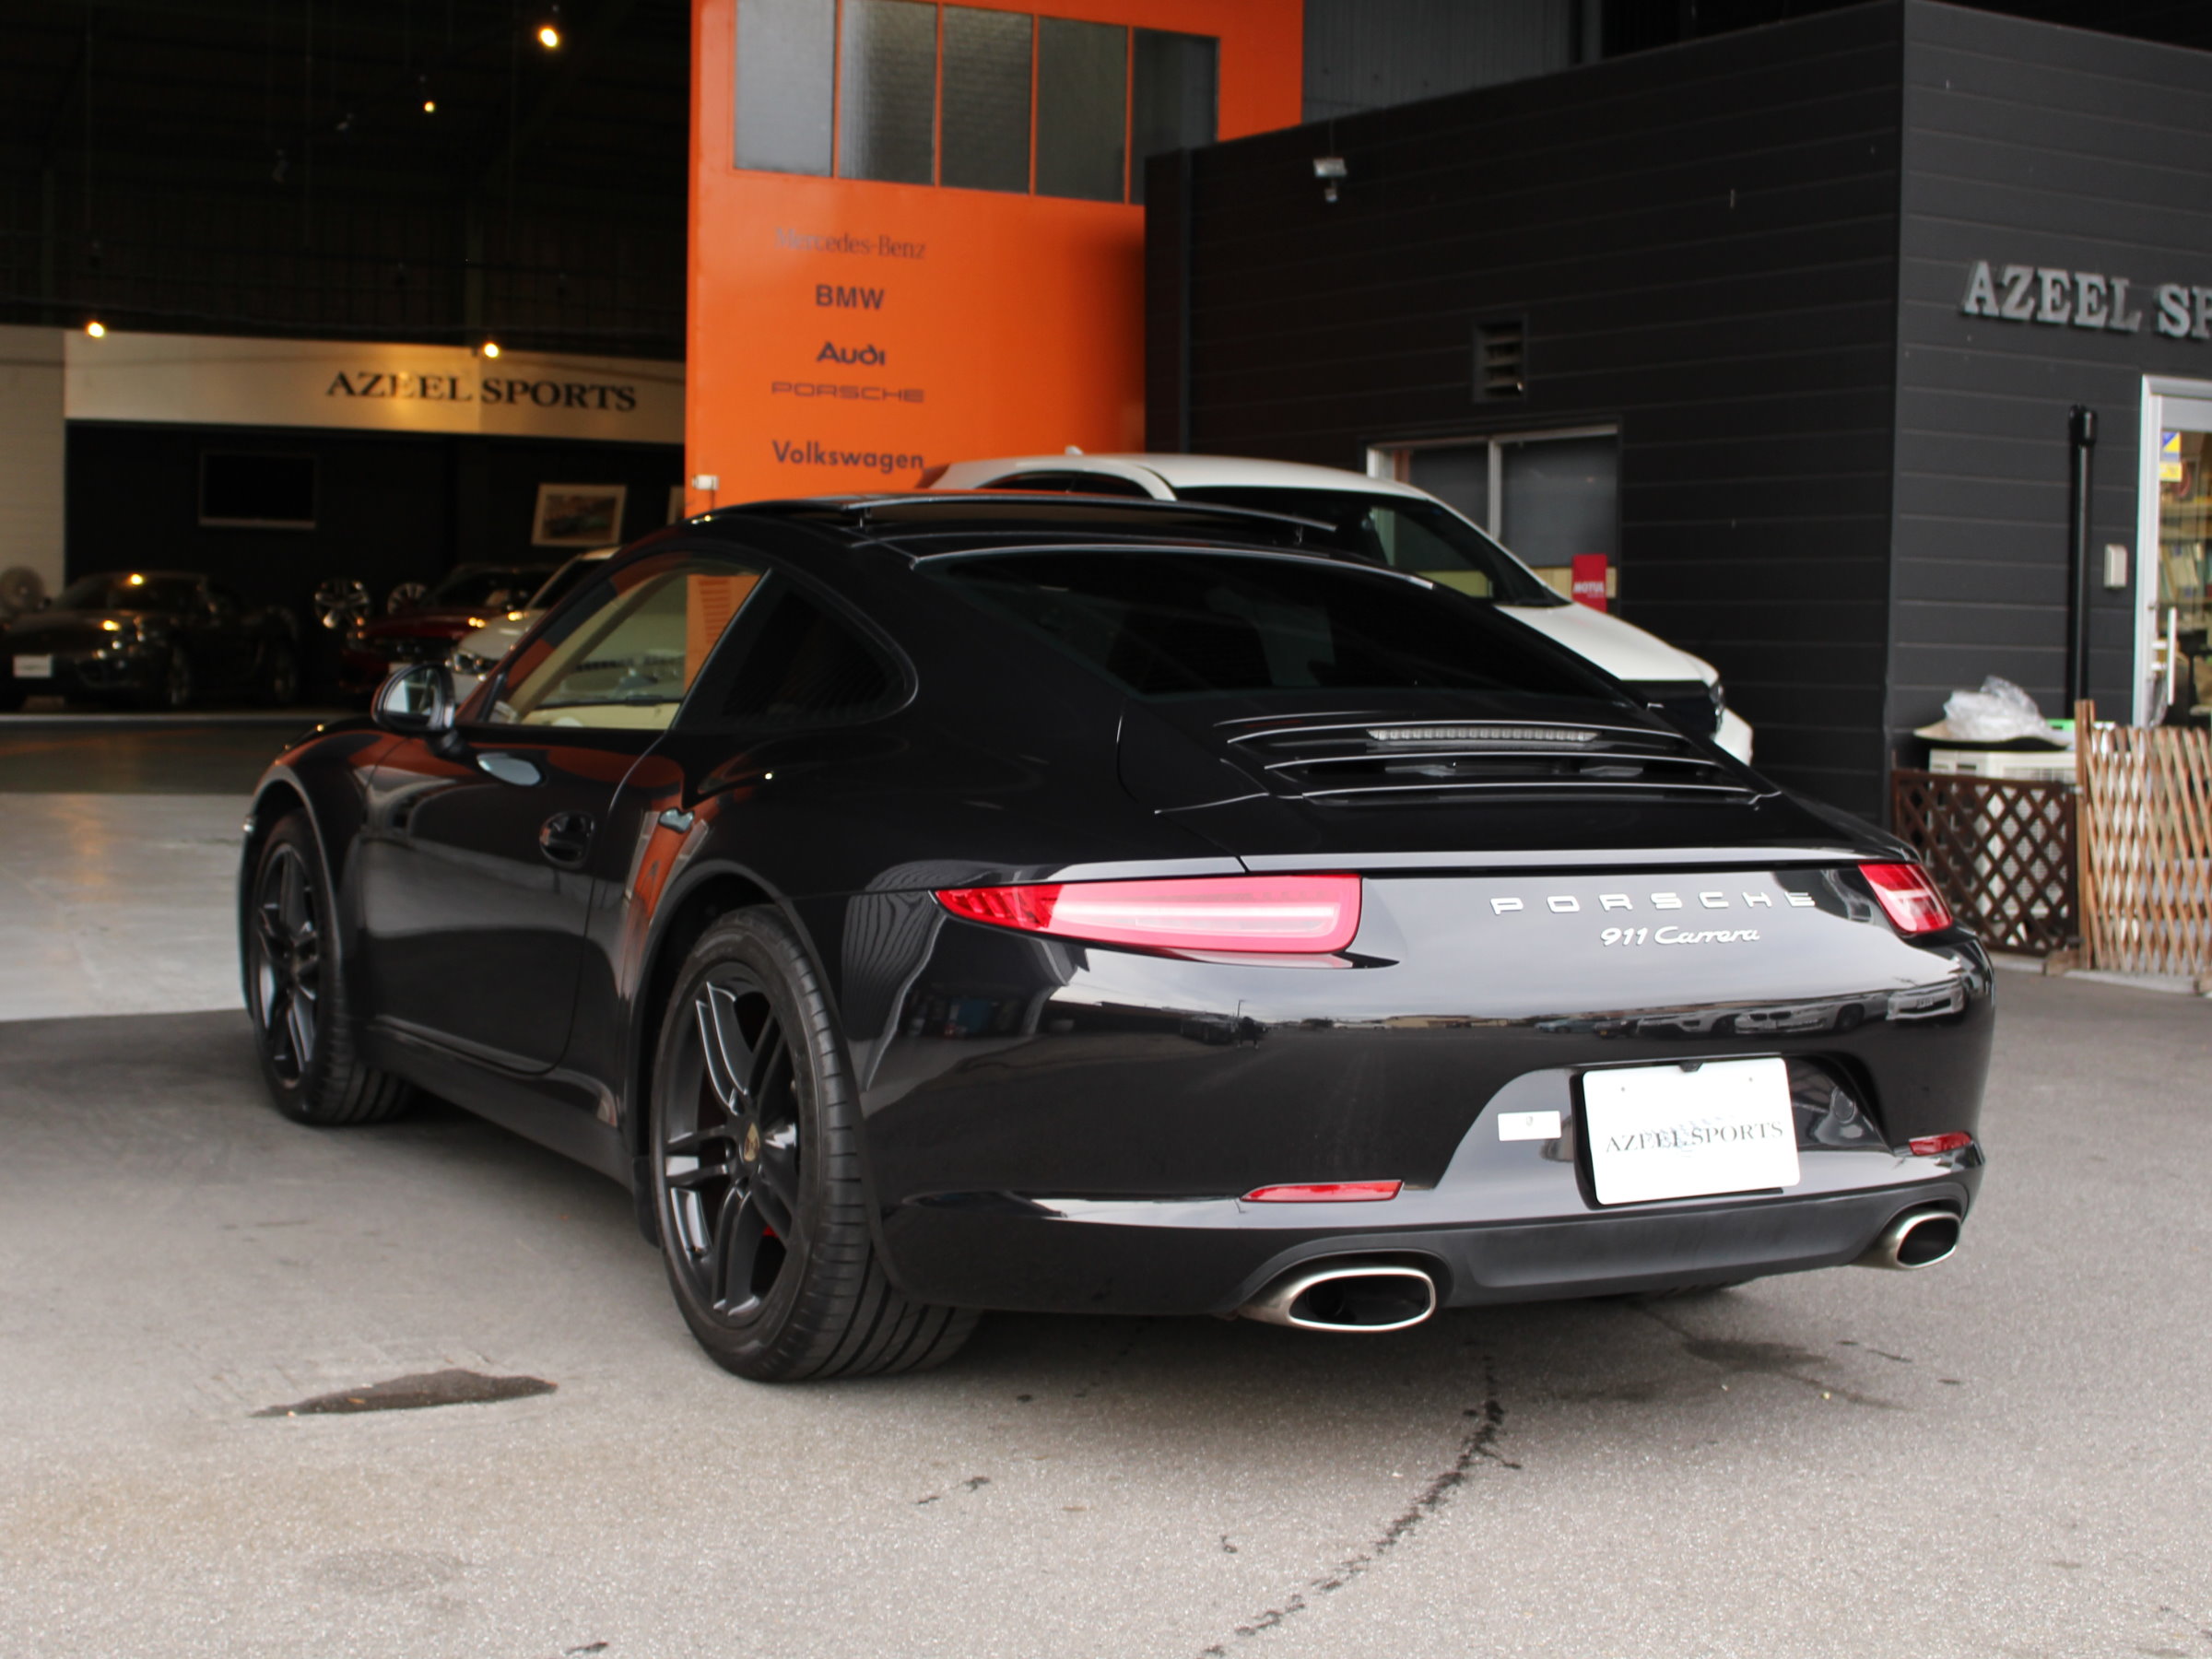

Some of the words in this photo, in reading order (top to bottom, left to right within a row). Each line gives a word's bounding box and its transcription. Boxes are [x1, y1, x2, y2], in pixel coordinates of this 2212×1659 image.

[774, 227, 926, 259] Mercedes-Benz
[816, 284, 885, 310] BMW
[1963, 259, 2142, 332] AZEEL
[817, 341, 886, 366] Audi
[325, 371, 472, 402] AZEEL
[480, 377, 637, 412] SPORTS
[771, 381, 924, 403] PORSCHE
[771, 440, 924, 474] Volkswagen
[1490, 891, 1816, 915] PORSCHE
[1600, 927, 1648, 947] 911
[1654, 925, 1760, 945] Carrera
[1606, 1128, 1688, 1153] AZEEL
[1691, 1120, 1784, 1146] SPORTS
